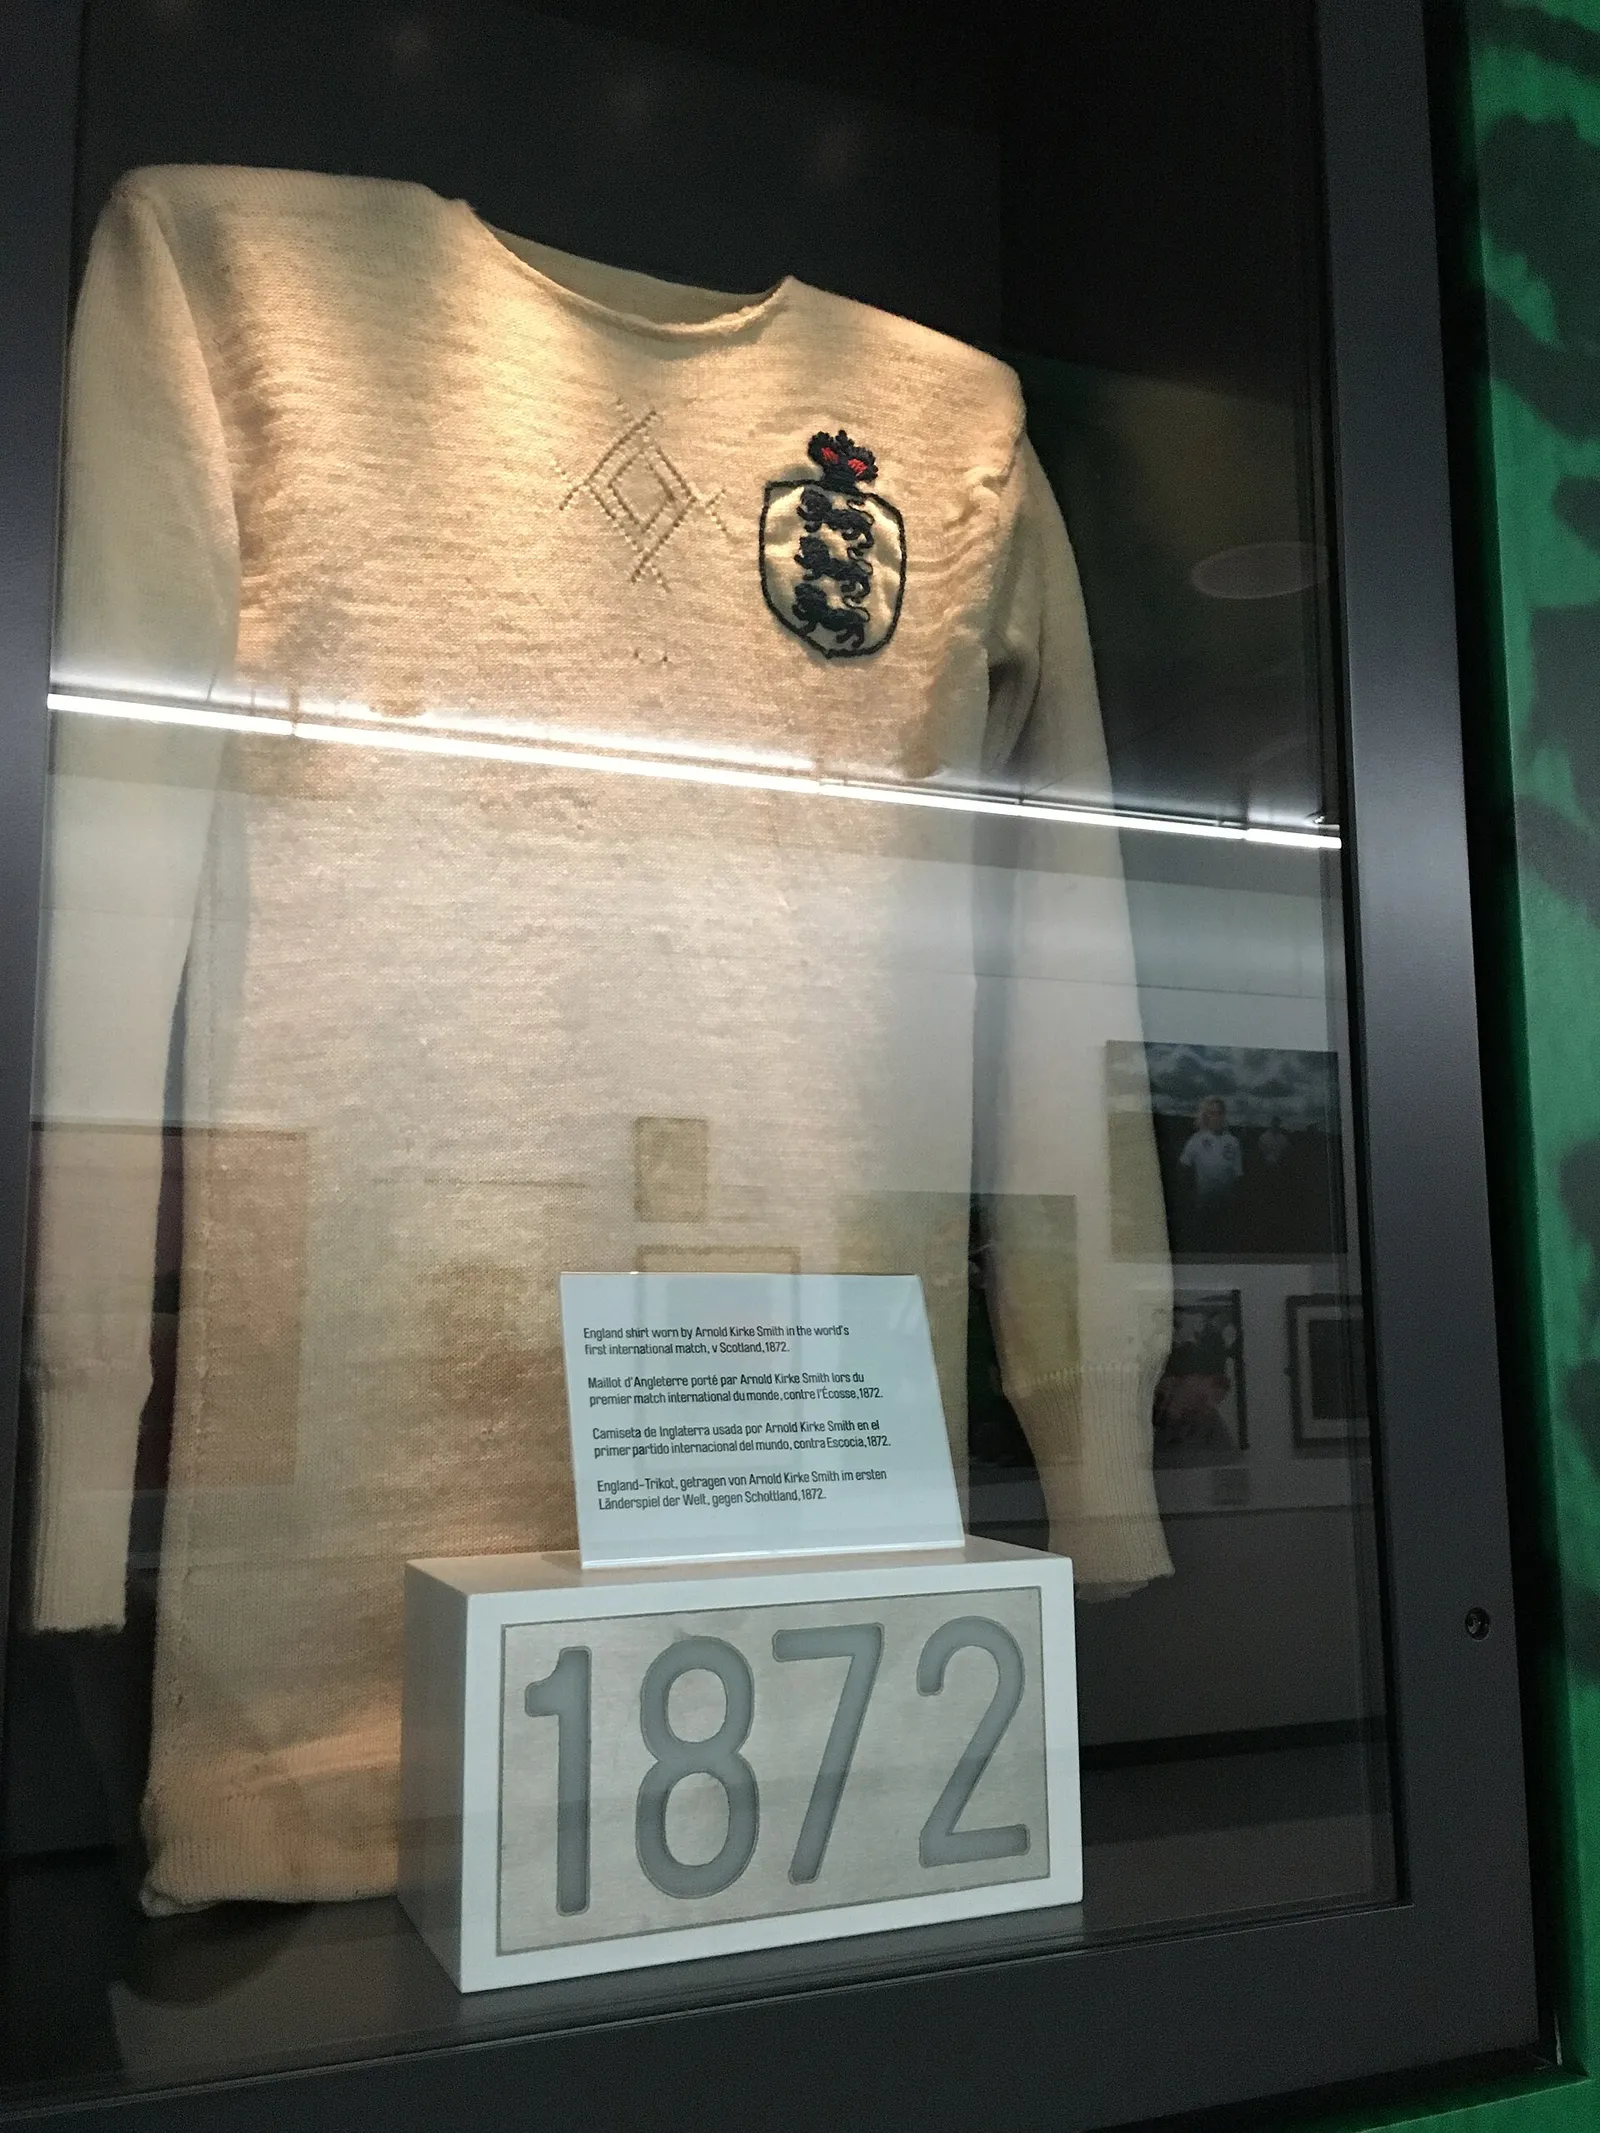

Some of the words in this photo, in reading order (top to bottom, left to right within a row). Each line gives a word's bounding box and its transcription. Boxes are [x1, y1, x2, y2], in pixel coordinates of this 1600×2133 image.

[584, 1328, 623, 1341] England
[626, 1327, 649, 1339] shirt
[652, 1329, 679, 1338] worn
[681, 1327, 692, 1340] by
[696, 1326, 727, 1338] Arnold
[730, 1326, 755, 1337] Kirke
[757, 1326, 784, 1337] Smith
[786, 1326, 794, 1336] in
[796, 1326, 811, 1336] the
[814, 1325, 849, 1336] world's
[585, 1344, 607, 1355] first
[609, 1344, 673, 1354] international
[675, 1343, 710, 1354] match,
[712, 1345, 718, 1353] v
[720, 1342, 764, 1354] Scotland,
[765, 1341, 789, 1352] 1872.
[588, 1377, 622, 1388] Maillot
[625, 1375, 688, 1390] d'Angleterre
[691, 1374, 718, 1388] porté
[721, 1377, 738, 1387] par
[740, 1374, 772, 1385] Arnold
[775, 1373, 800, 1384] Kirke
[802, 1373, 829, 1383] Smith
[832, 1373, 851, 1382] lors
[853, 1372, 864, 1382] du
[590, 1394, 632, 1407] premier
[634, 1392, 666, 1404] match
[668, 1390, 731, 1403] international
[733, 1390, 745, 1401] du
[746, 1389, 782, 1402] monde,
[784, 1390, 815, 1400] contre
[817, 1387, 859, 1400] l'Écosse,
[859, 1388, 883, 1398] 1872.
[593, 1427, 641, 1439] Camiseta
[644, 1426, 656, 1437] de
[660, 1425, 710, 1440] Inglaterra
[713, 1423, 742, 1435] usada
[746, 1424, 762, 1436] por
[765, 1422, 797, 1433] Arnold
[800, 1421, 825, 1432] Kirke
[828, 1421, 855, 1431] Smith
[857, 1422, 869, 1431] en
[871, 1420, 879, 1430] el
[594, 1445, 631, 1458] primer
[633, 1444, 669, 1457] partido
[671, 1441, 737, 1454] internacional
[739, 1440, 754, 1451] del
[756, 1439, 792, 1451] mundo,
[794, 1438, 825, 1449] contra
[827, 1437, 866, 1449] Escocia,
[867, 1436, 890, 1447] 1872.
[597, 1478, 678, 1495] England-Trikot,
[680, 1478, 725, 1490] getragen
[728, 1477, 747, 1486] von
[749, 1473, 781, 1485] Arnold
[784, 1472, 809, 1483] Kirke
[812, 1471, 839, 1482] Smith
[841, 1471, 853, 1481] im
[856, 1470, 886, 1480] ersten
[599, 1496, 660, 1512] Länderspiel
[663, 1496, 680, 1507] der
[683, 1495, 709, 1507] Welt,
[712, 1494, 742, 1507] gegen
[745, 1490, 800, 1503] Schottland,
[801, 1489, 826, 1500] 1872.
[524, 1616, 1030, 1916] 1872
